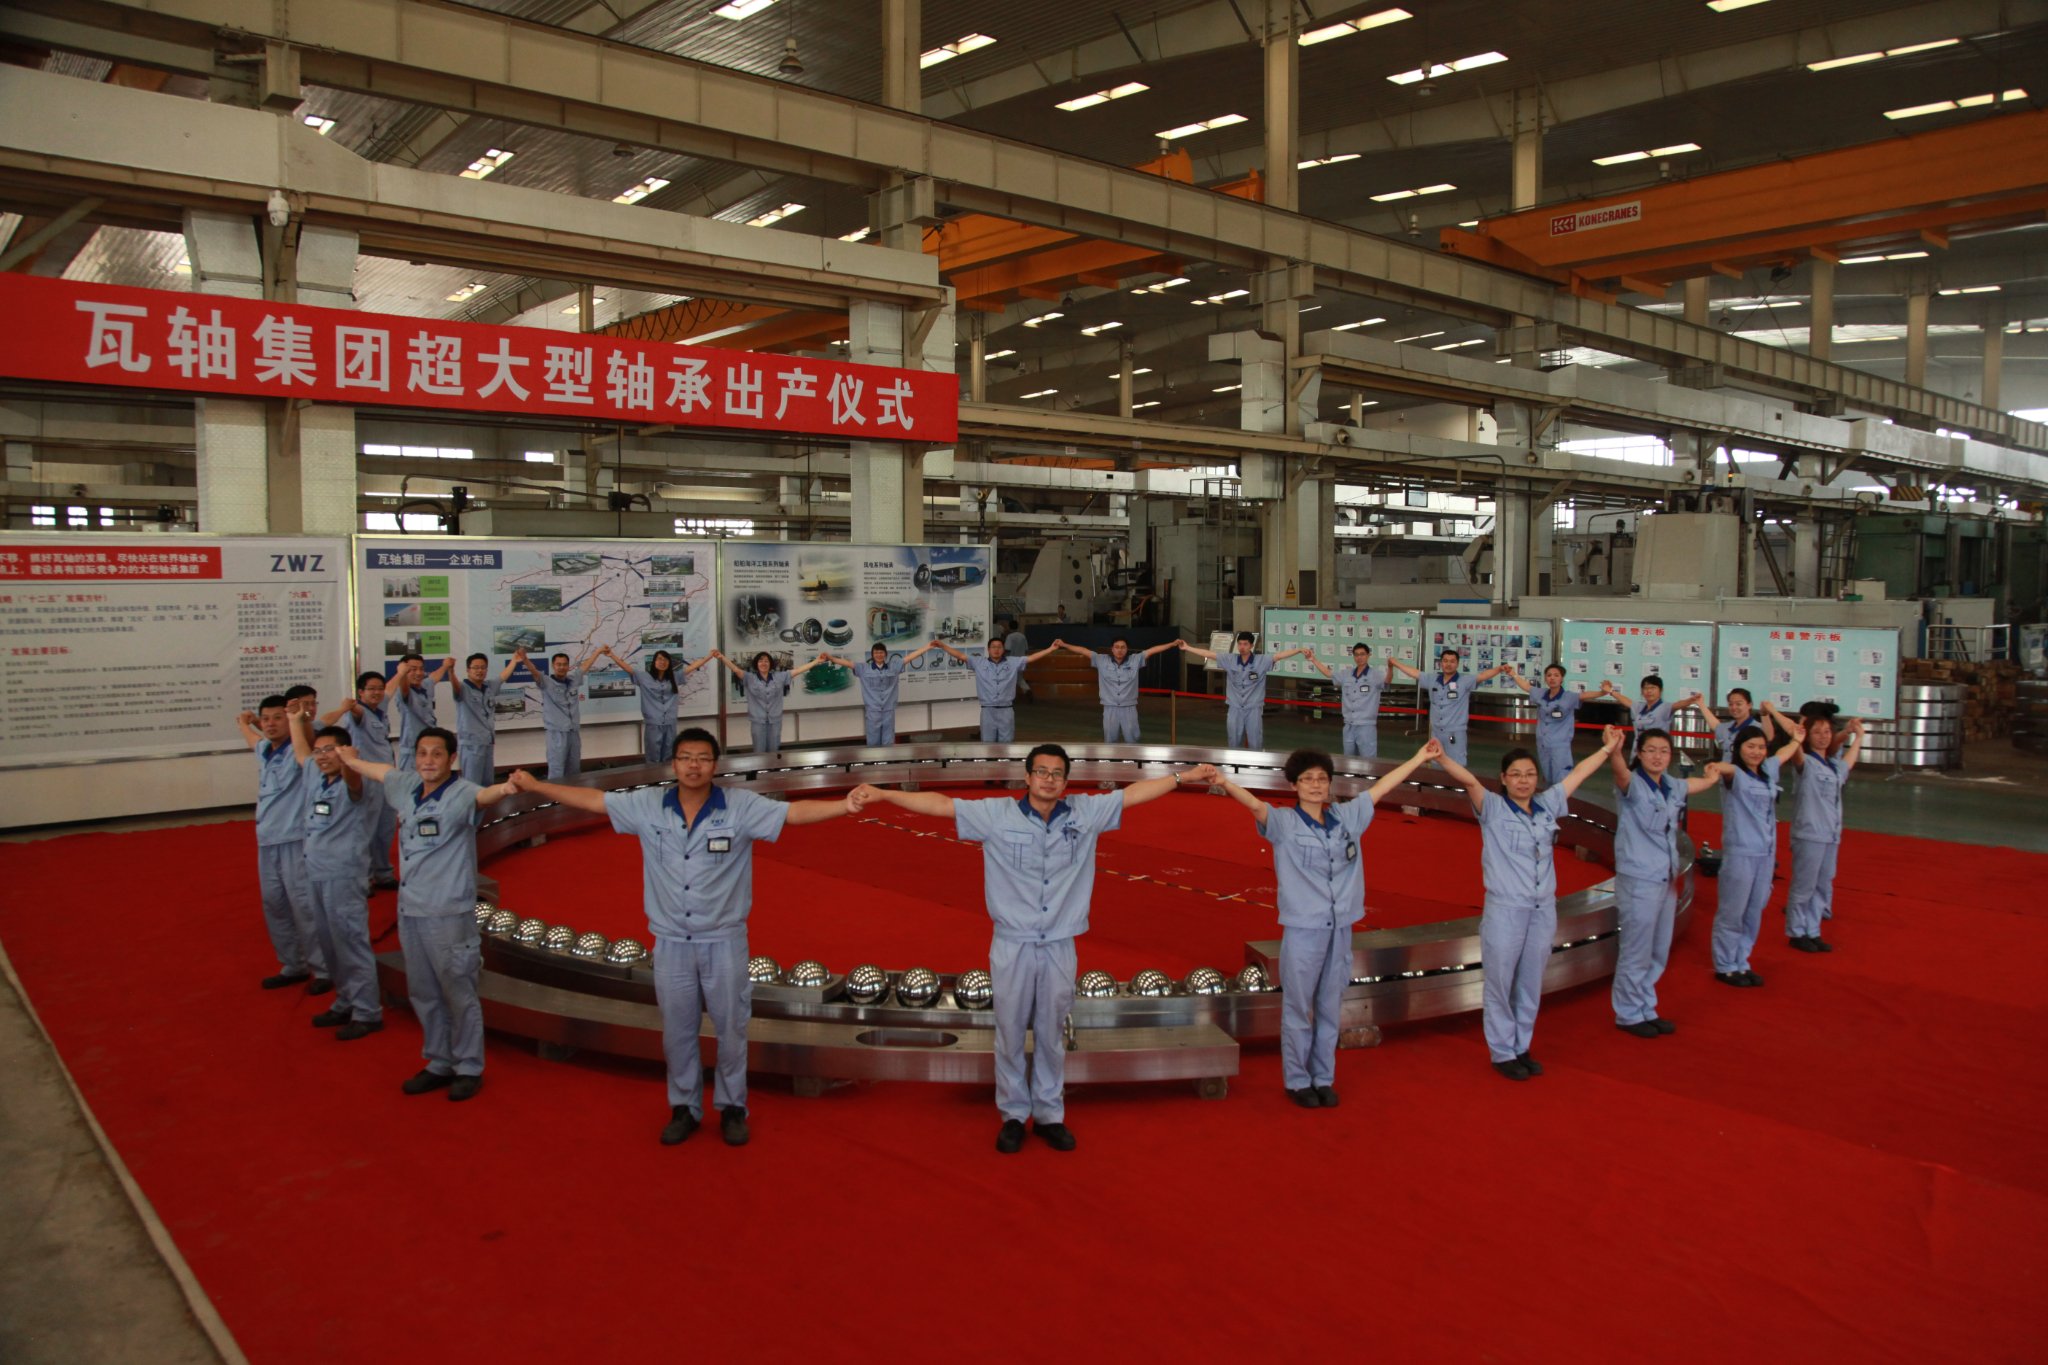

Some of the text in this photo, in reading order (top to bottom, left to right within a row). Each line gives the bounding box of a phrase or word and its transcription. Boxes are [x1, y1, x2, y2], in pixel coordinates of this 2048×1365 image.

[1578, 205, 1639, 227] KONECRANES
[74, 300, 915, 430] 瓦轴集团超大型轴承出产仪式
[271, 555, 325, 572] ZWZ
[377, 553, 495, 566] 瓦轴集团——企业布局
[863, 561, 894, 569] 风电系列轴承
[1604, 626, 1665, 636] 质量警示板
[1769, 631, 1842, 642] 质量警示板
